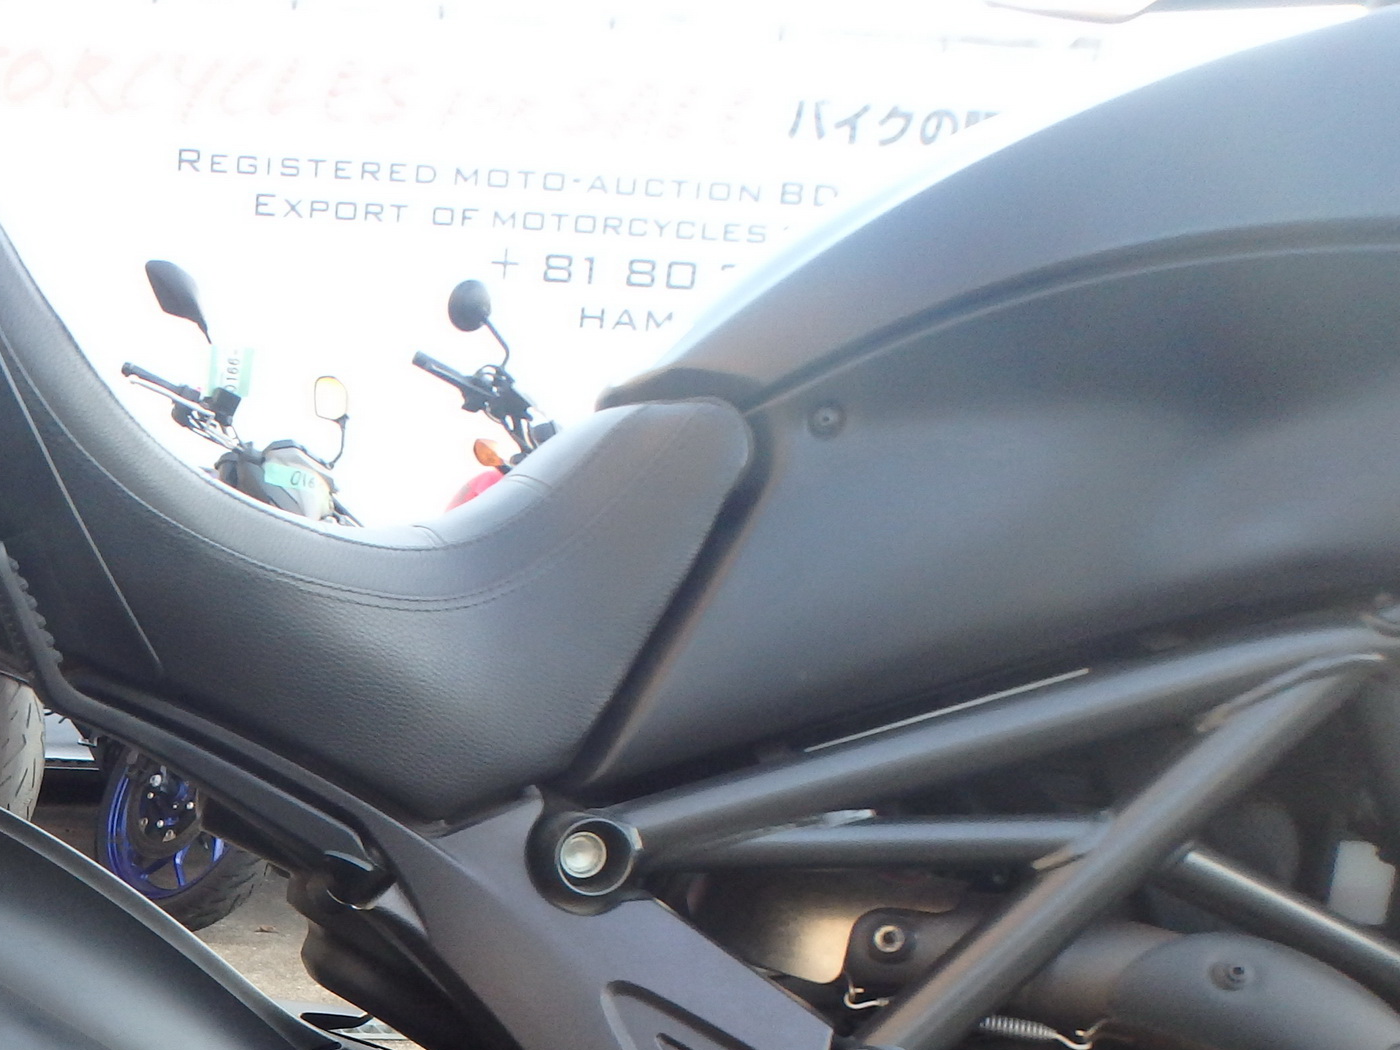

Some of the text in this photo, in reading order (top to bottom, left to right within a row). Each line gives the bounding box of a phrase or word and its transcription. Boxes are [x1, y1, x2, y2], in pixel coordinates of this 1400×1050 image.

[787, 99, 1001, 147] バイクの
[432, 206, 480, 228] OF
[493, 210, 767, 244] MOTORCYCLES
[542, 253, 595, 285] 81
[625, 257, 698, 291] 80
